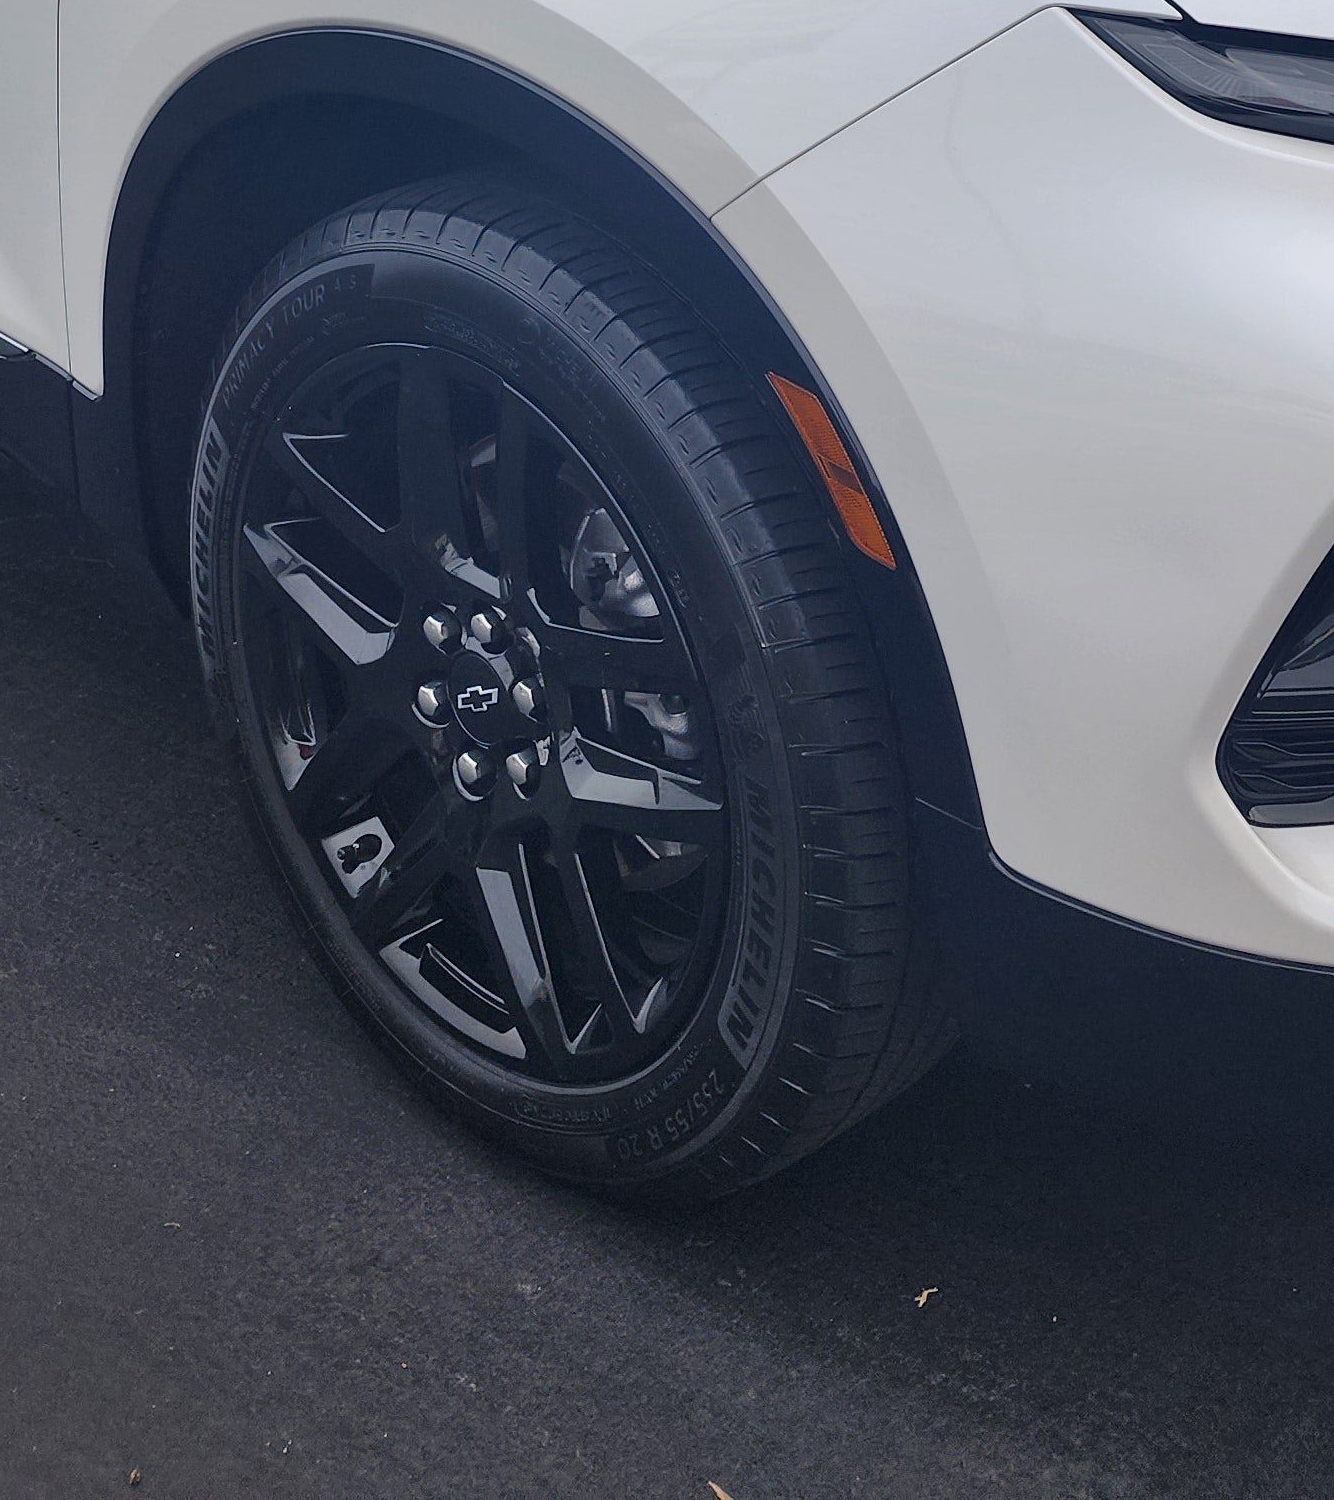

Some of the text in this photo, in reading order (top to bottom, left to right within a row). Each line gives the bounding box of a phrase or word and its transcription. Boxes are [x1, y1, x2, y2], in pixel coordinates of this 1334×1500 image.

[222, 317, 275, 410] PRIMACY
[282, 284, 325, 326] TOUR
[194, 430, 223, 661] MICHELIN
[726, 776, 777, 1051] MICHELIN
